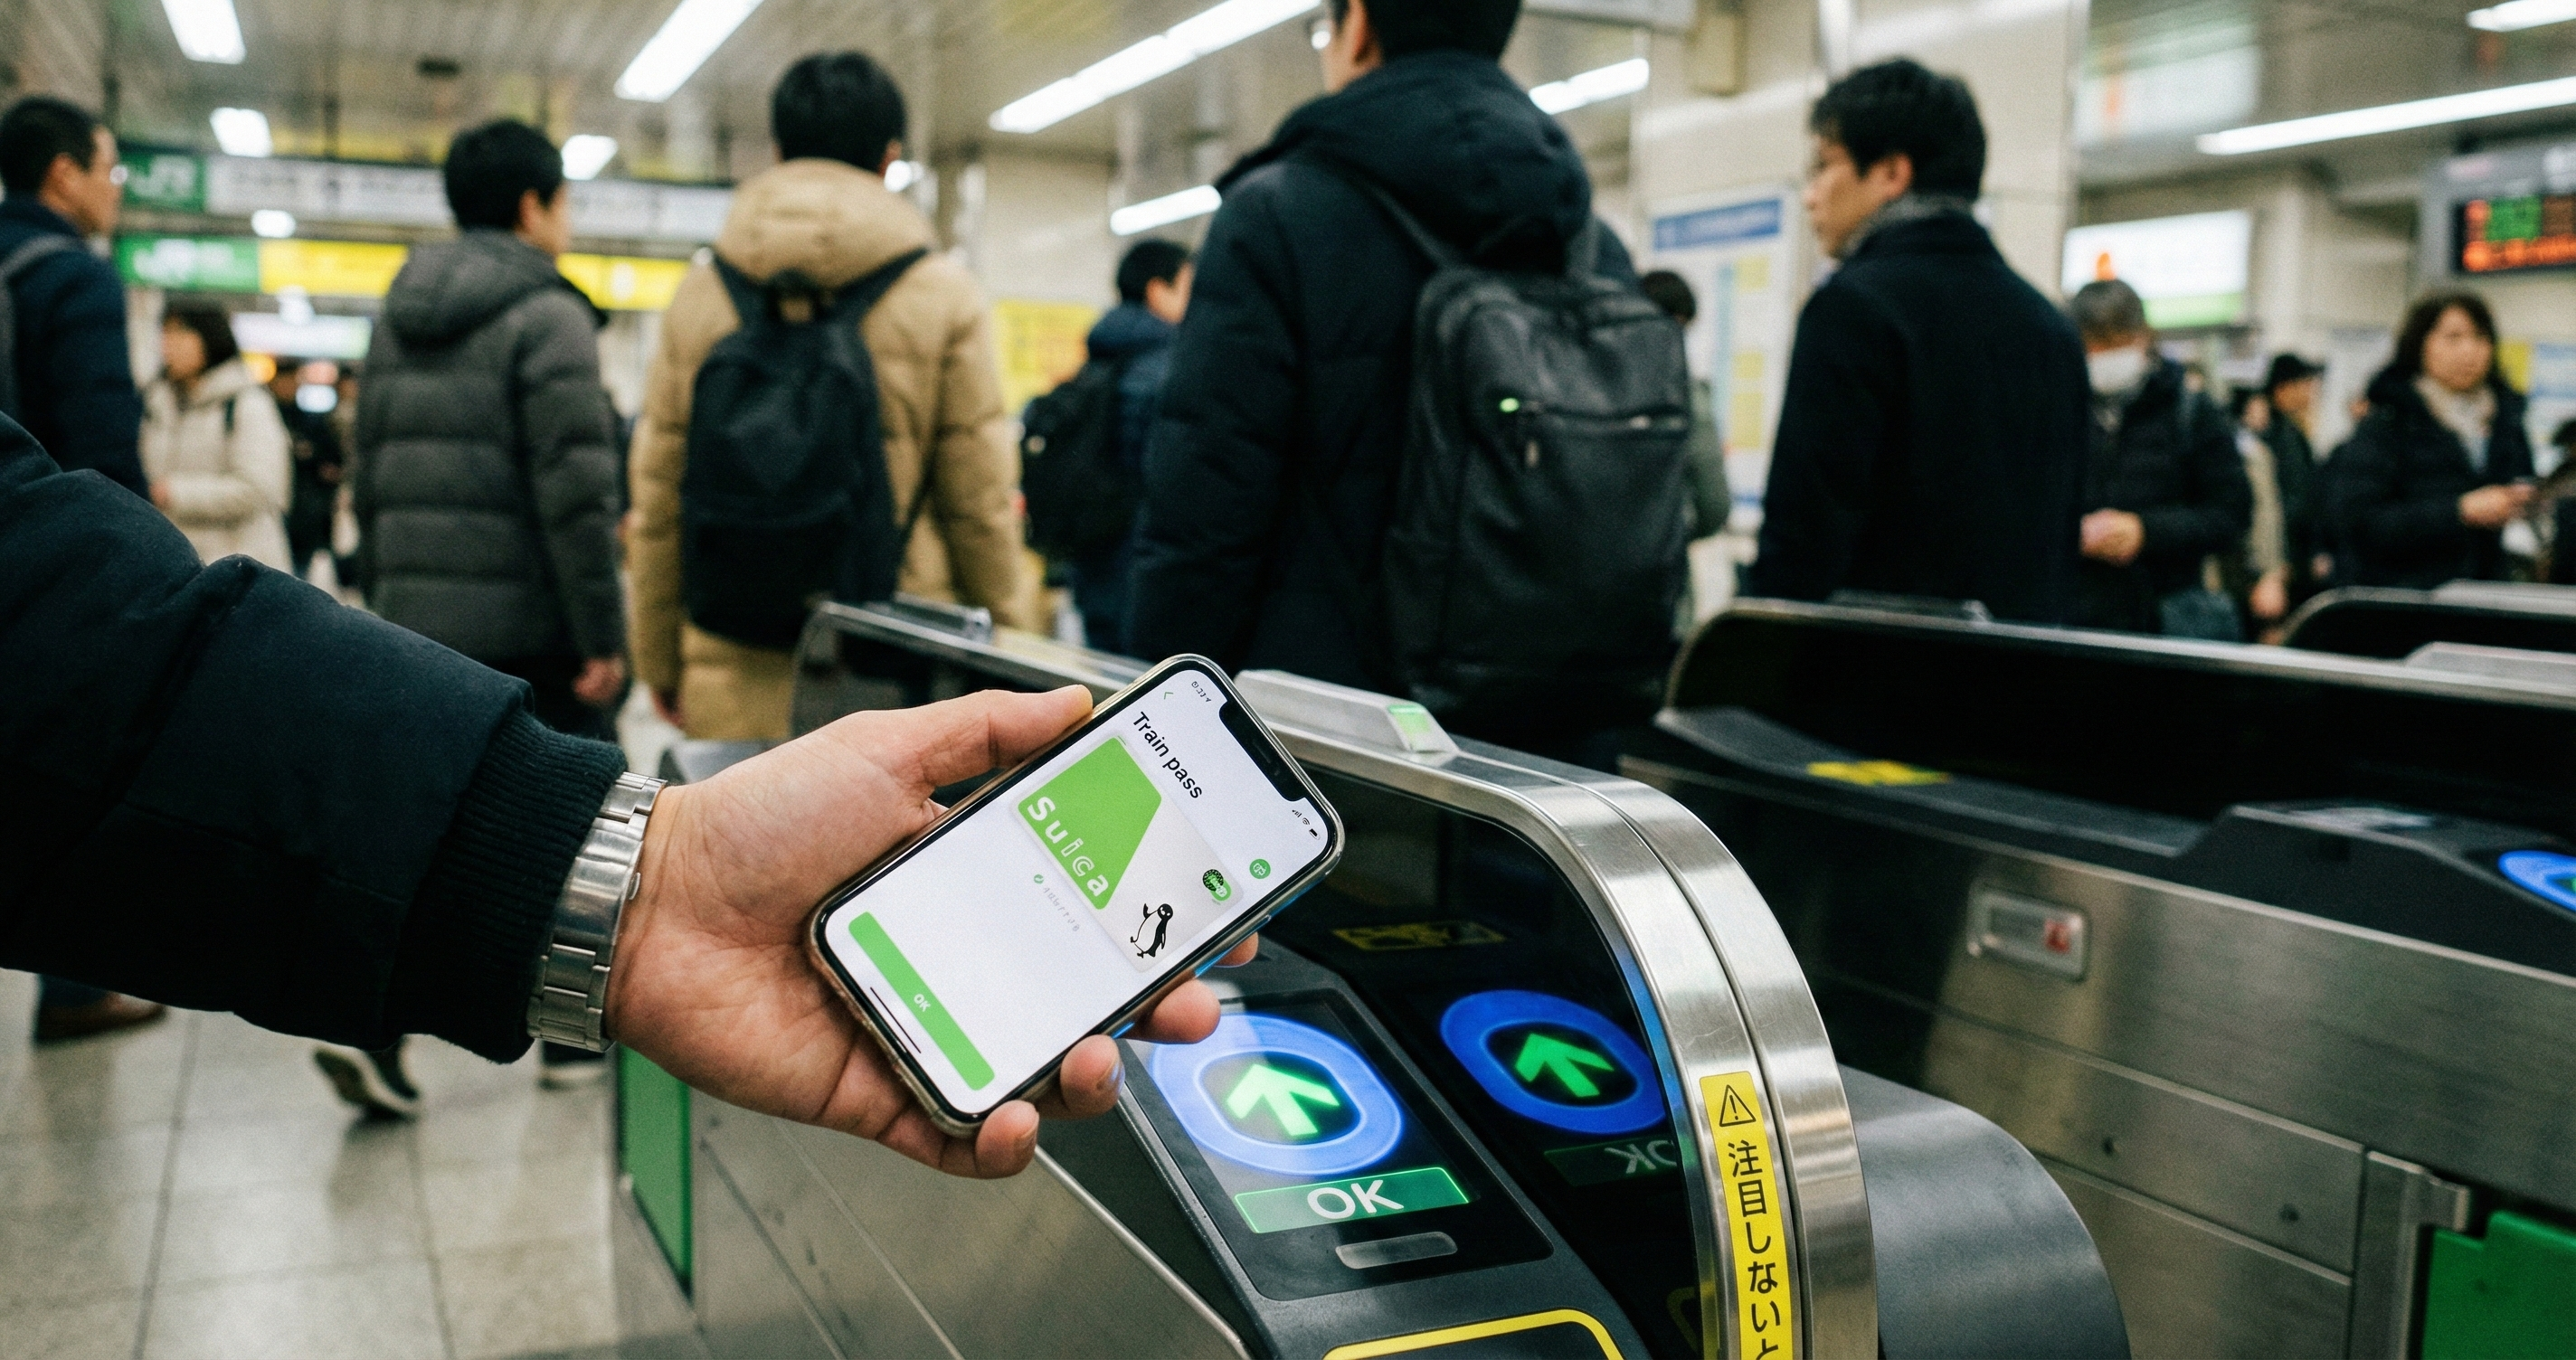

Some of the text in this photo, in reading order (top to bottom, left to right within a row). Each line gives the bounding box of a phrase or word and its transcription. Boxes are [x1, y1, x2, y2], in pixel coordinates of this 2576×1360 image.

[1133, 711, 1202, 798] Train pass
[1027, 797, 1109, 897] Suica
[914, 994, 931, 1013] OK
[1307, 1179, 1405, 1220] OK
